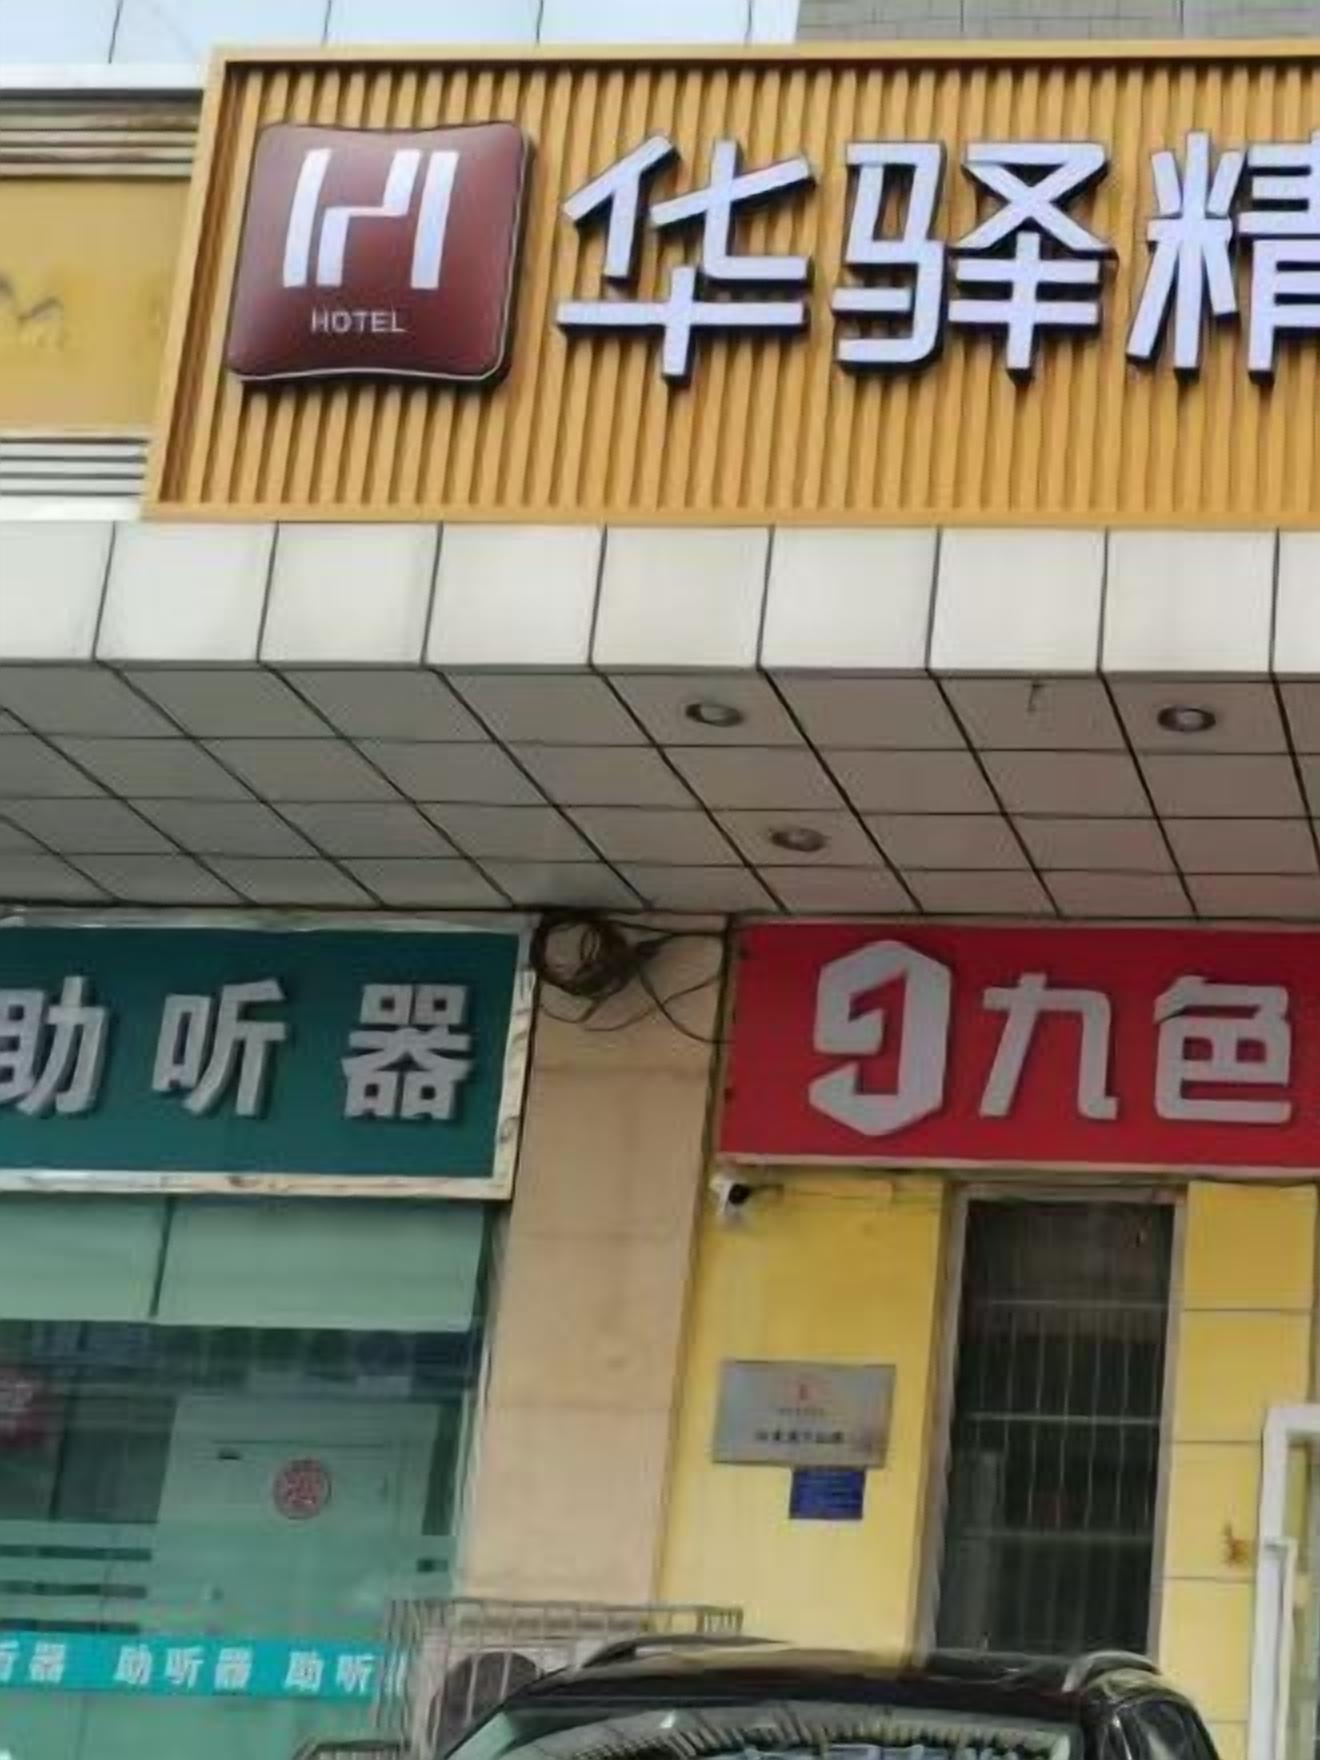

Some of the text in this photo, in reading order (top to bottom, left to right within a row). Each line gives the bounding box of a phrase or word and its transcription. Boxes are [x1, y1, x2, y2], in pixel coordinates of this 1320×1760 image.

[310, 308, 407, 335] HOTEL
[0, 974, 474, 1121] 助听器
[113, 1643, 254, 1690] 助听器
